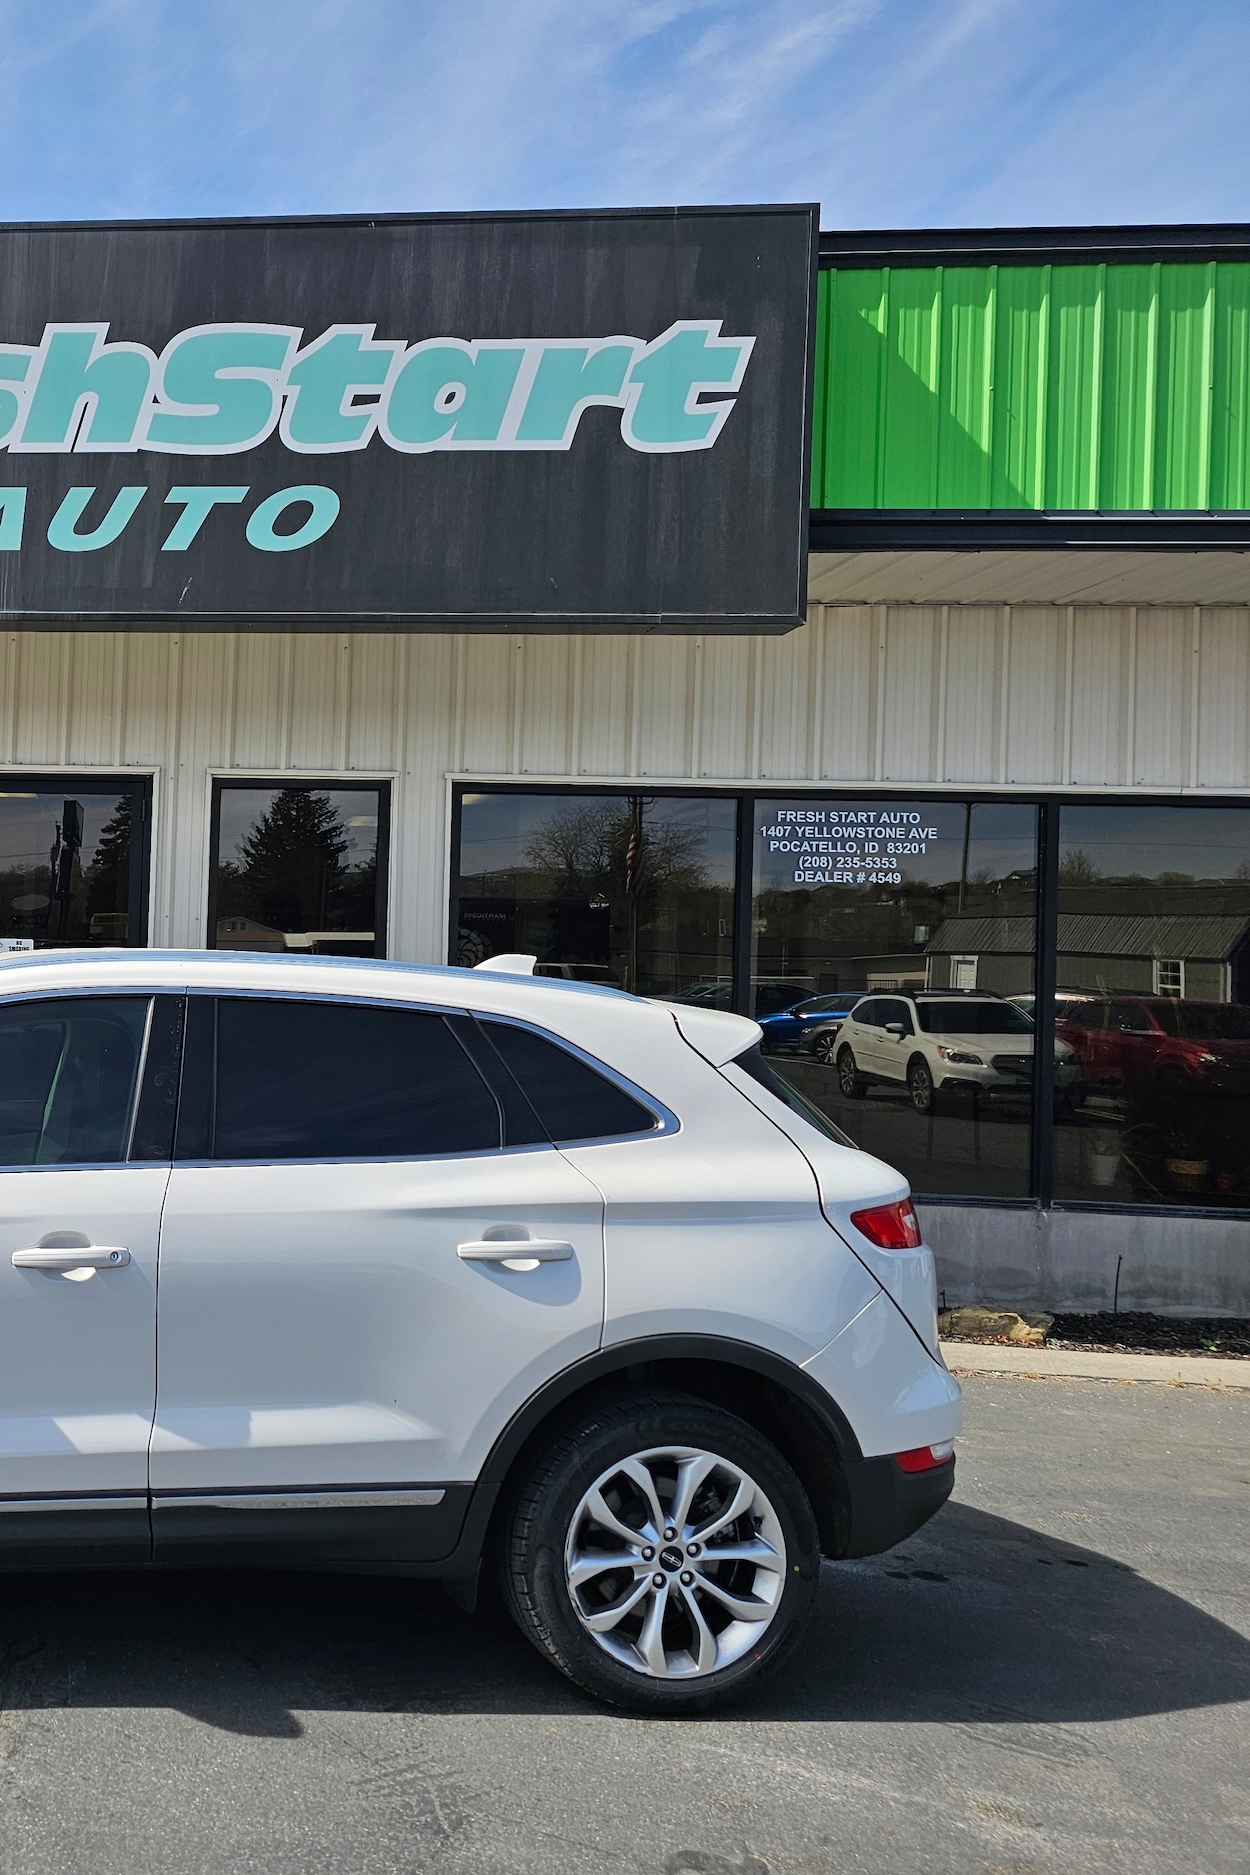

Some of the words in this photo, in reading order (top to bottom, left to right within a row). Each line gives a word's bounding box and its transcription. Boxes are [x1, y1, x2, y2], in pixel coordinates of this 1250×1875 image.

[777, 810, 825, 823] FRESH
[829, 811, 877, 823] START
[879, 812, 921, 824] AUTO
[760, 825, 792, 837] 1407
[795, 826, 905, 839] YELLOWSTONE
[908, 828, 938, 839] AVE
[769, 840, 860, 856] POCATELLO,
[864, 842, 879, 853] ID
[887, 842, 927, 854] 83201
[798, 855, 833, 870] (208)
[836, 857, 897, 869] 235-5353
[794, 870, 853, 883] DEALER
[856, 871, 866, 883] #
[868, 872, 902, 884] 4549
